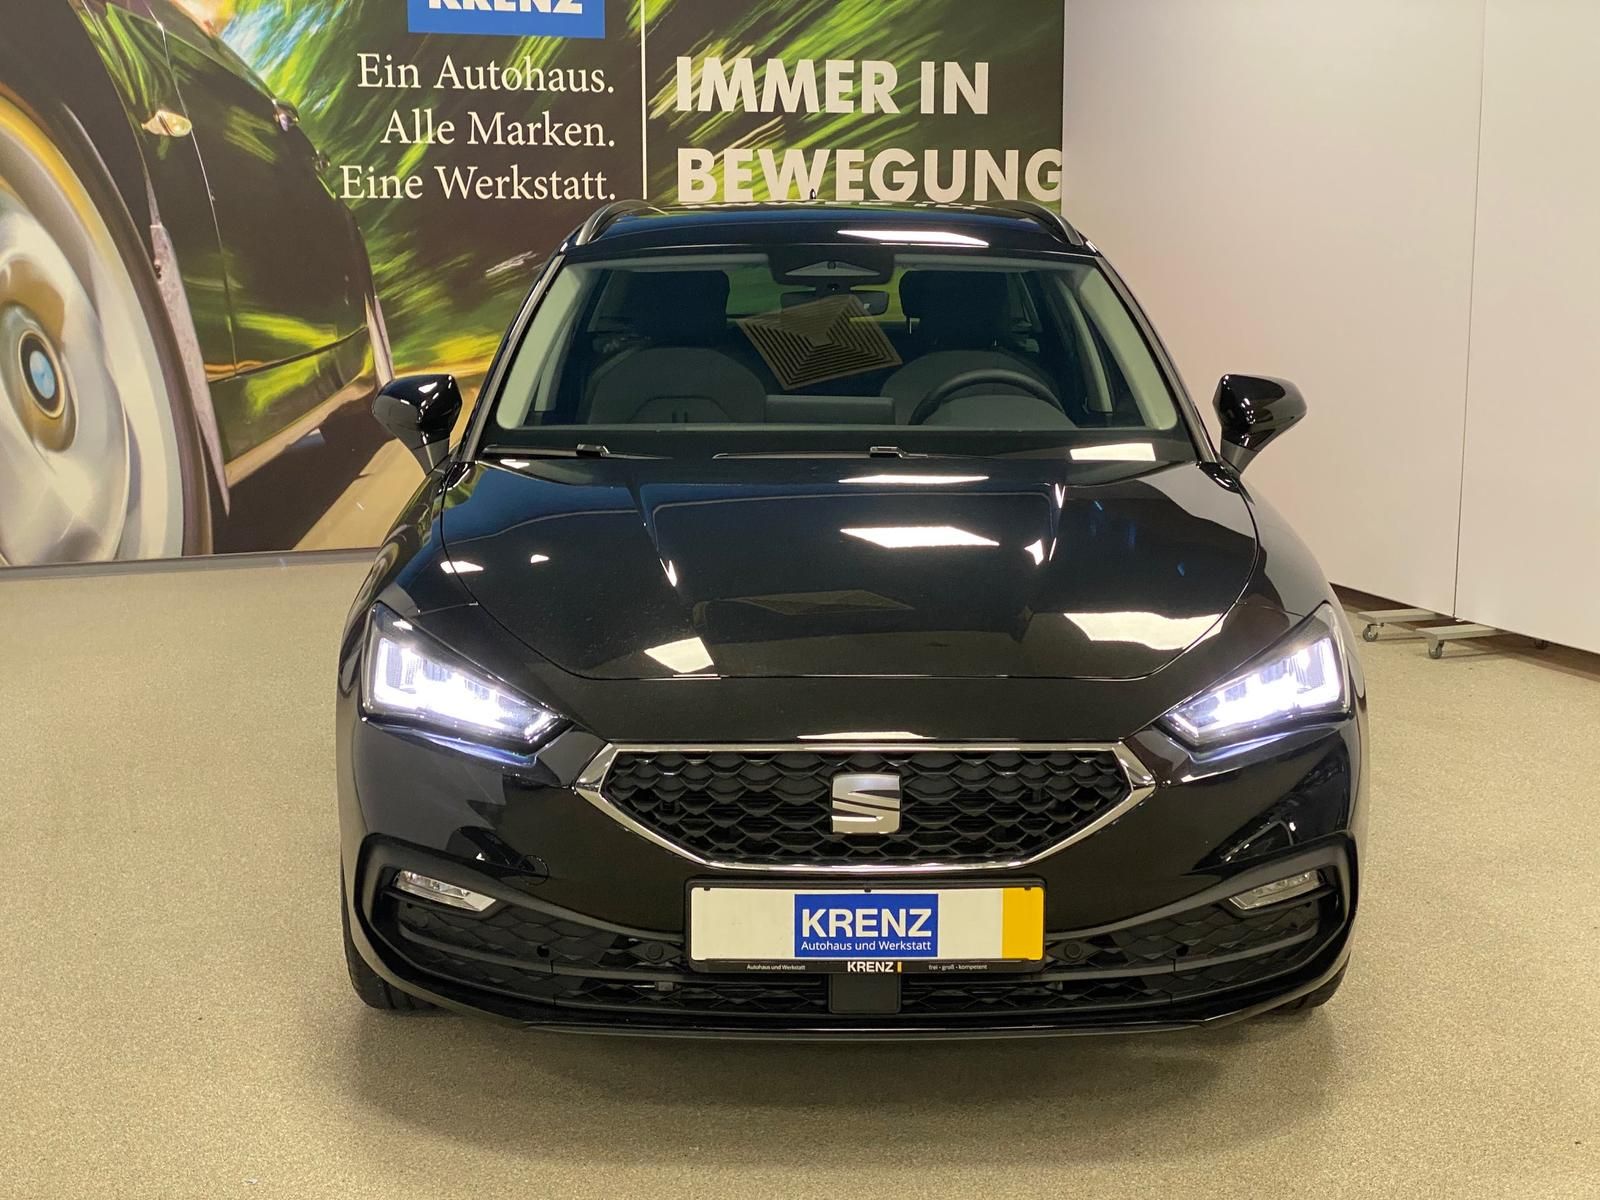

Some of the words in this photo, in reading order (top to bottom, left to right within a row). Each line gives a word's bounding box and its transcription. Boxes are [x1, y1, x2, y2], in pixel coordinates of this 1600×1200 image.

[357, 53, 421, 89] Ein
[433, 55, 615, 94] Autohaus.
[676, 56, 900, 114] IMMER
[920, 61, 989, 115] IN
[380, 108, 455, 145] Alle
[467, 111, 616, 147] Marken.
[339, 164, 423, 199] Eine
[434, 165, 616, 200] Werkstatt.
[677, 148, 1062, 201] BEWEGUNG
[802, 908, 932, 938] KRENZ
[801, 941, 852, 951] Autohaus
[855, 941, 876, 951] und
[878, 941, 932, 951] Werkstatt
[847, 961, 894, 973] KRENZ
